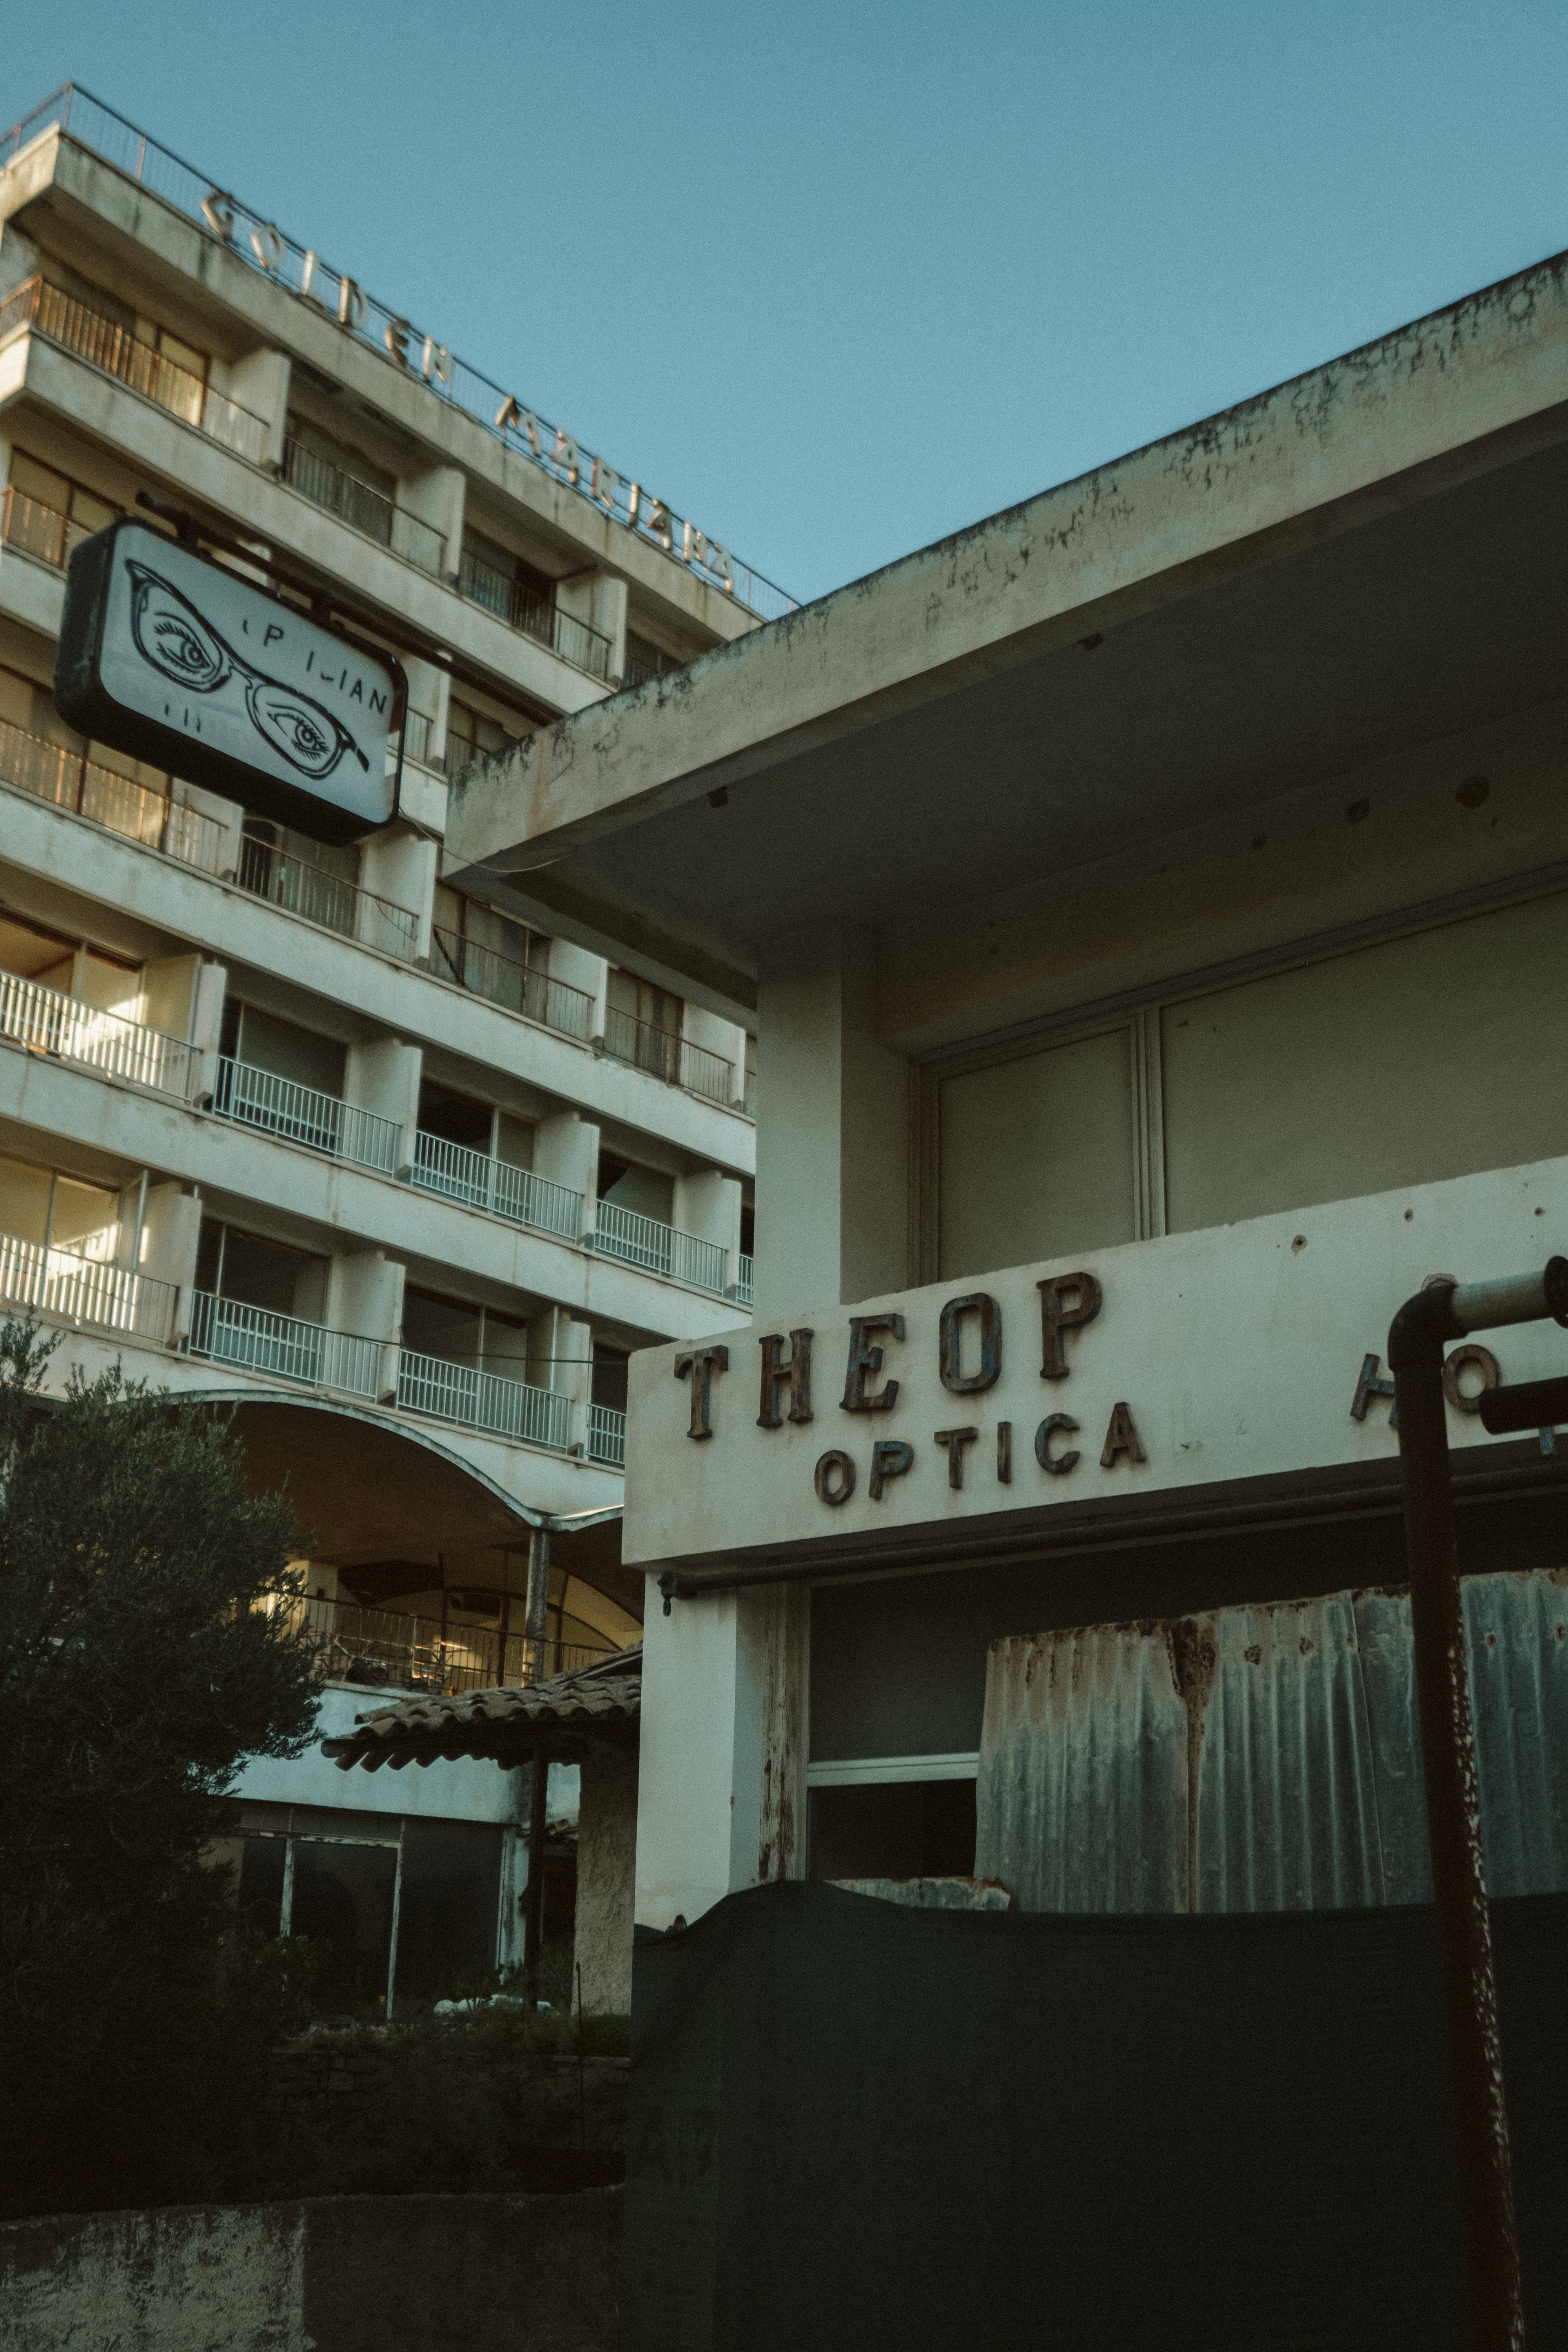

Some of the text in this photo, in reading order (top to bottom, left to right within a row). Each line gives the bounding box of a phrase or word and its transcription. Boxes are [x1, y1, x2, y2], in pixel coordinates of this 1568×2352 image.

[200, 186, 734, 593] GOLDEN MARIANA
[674, 1271, 1103, 1440] THEOP
[814, 1401, 1147, 1505] OPTICA
